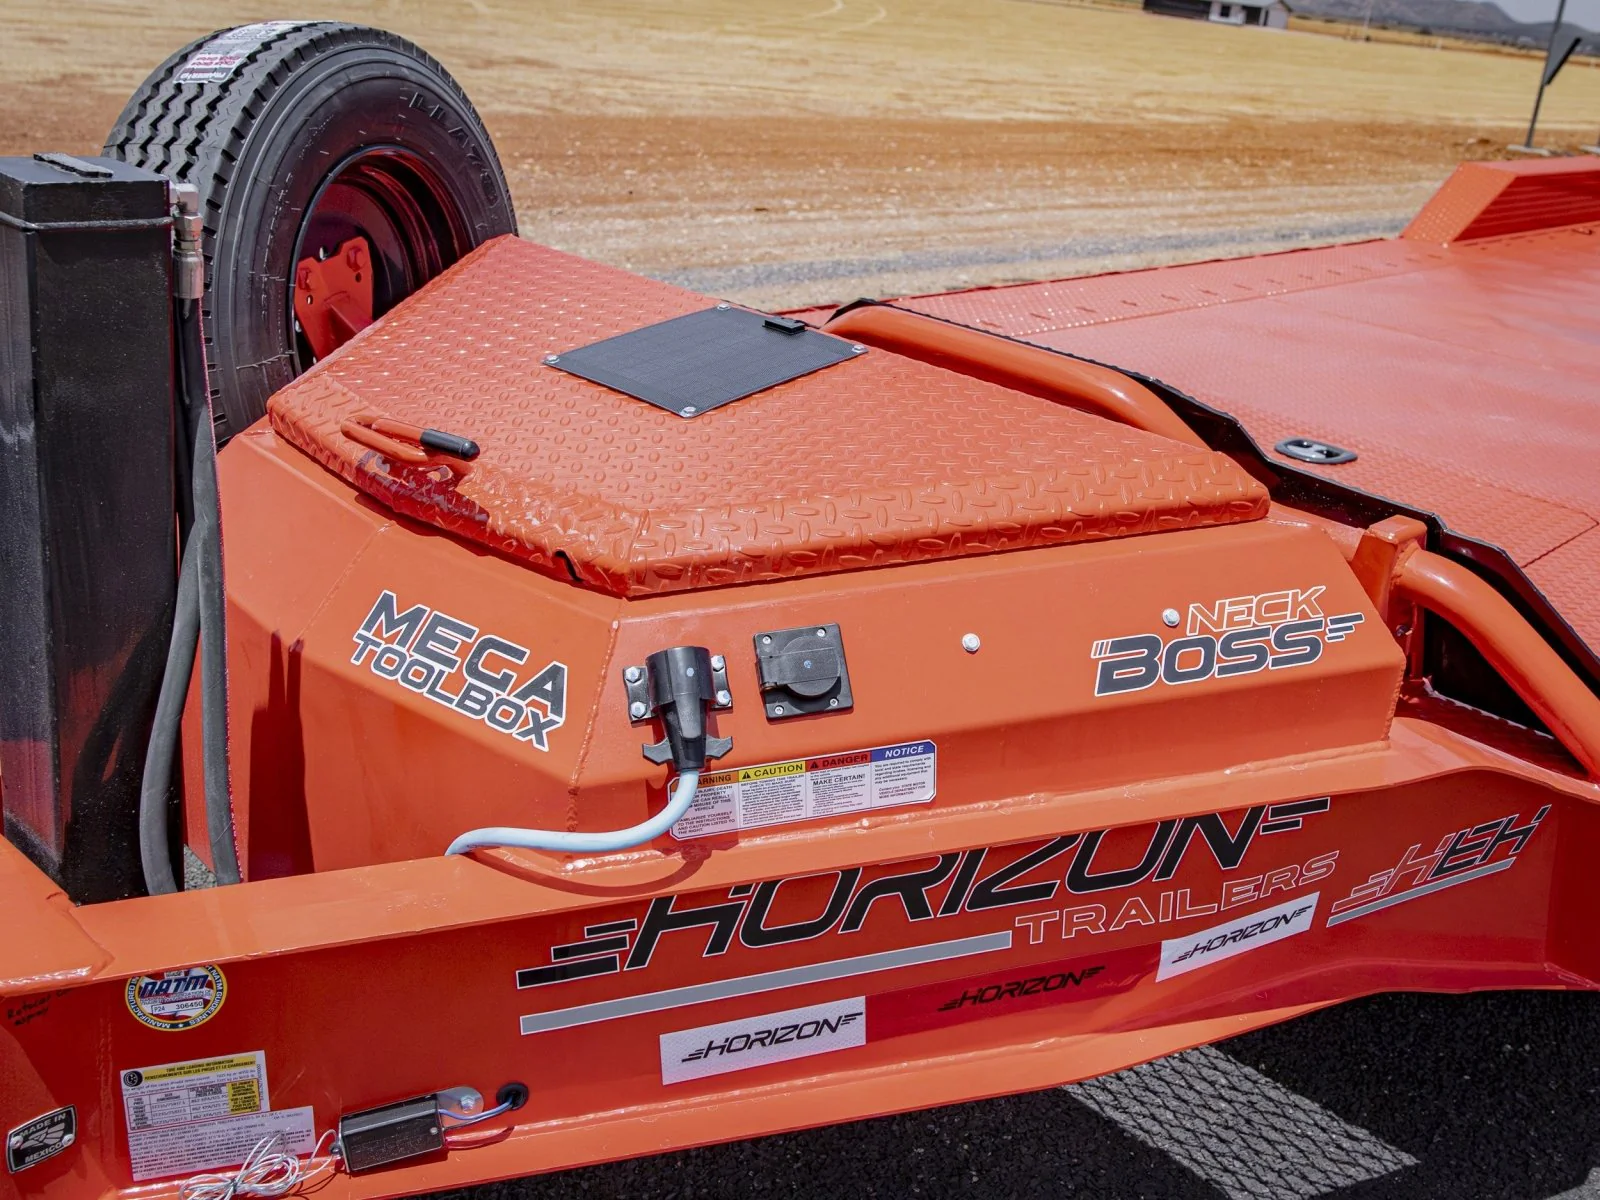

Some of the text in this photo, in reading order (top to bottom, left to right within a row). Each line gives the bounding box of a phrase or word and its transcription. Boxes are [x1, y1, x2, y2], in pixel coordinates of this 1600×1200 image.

[1187, 586, 1326, 636] NECK
[360, 589, 568, 722] MEGA
[1091, 618, 1325, 697] BOSS
[350, 631, 563, 752] TOOLBOX
[754, 763, 804, 778] CAUTION
[822, 754, 869, 767] DANGER
[884, 745, 925, 759] NOTICE
[697, 774, 732, 785] ARNING
[620, 804, 1262, 973] HORIZON
[1015, 850, 1340, 944] TRAILERS
[1186, 910, 1298, 959] HORIZON
[956, 969, 1088, 1006] HORIZON
[700, 1014, 844, 1060] HORIZON
[19, 1113, 67, 1138] MADE IN
[24, 1141, 63, 1164] MEXICO
